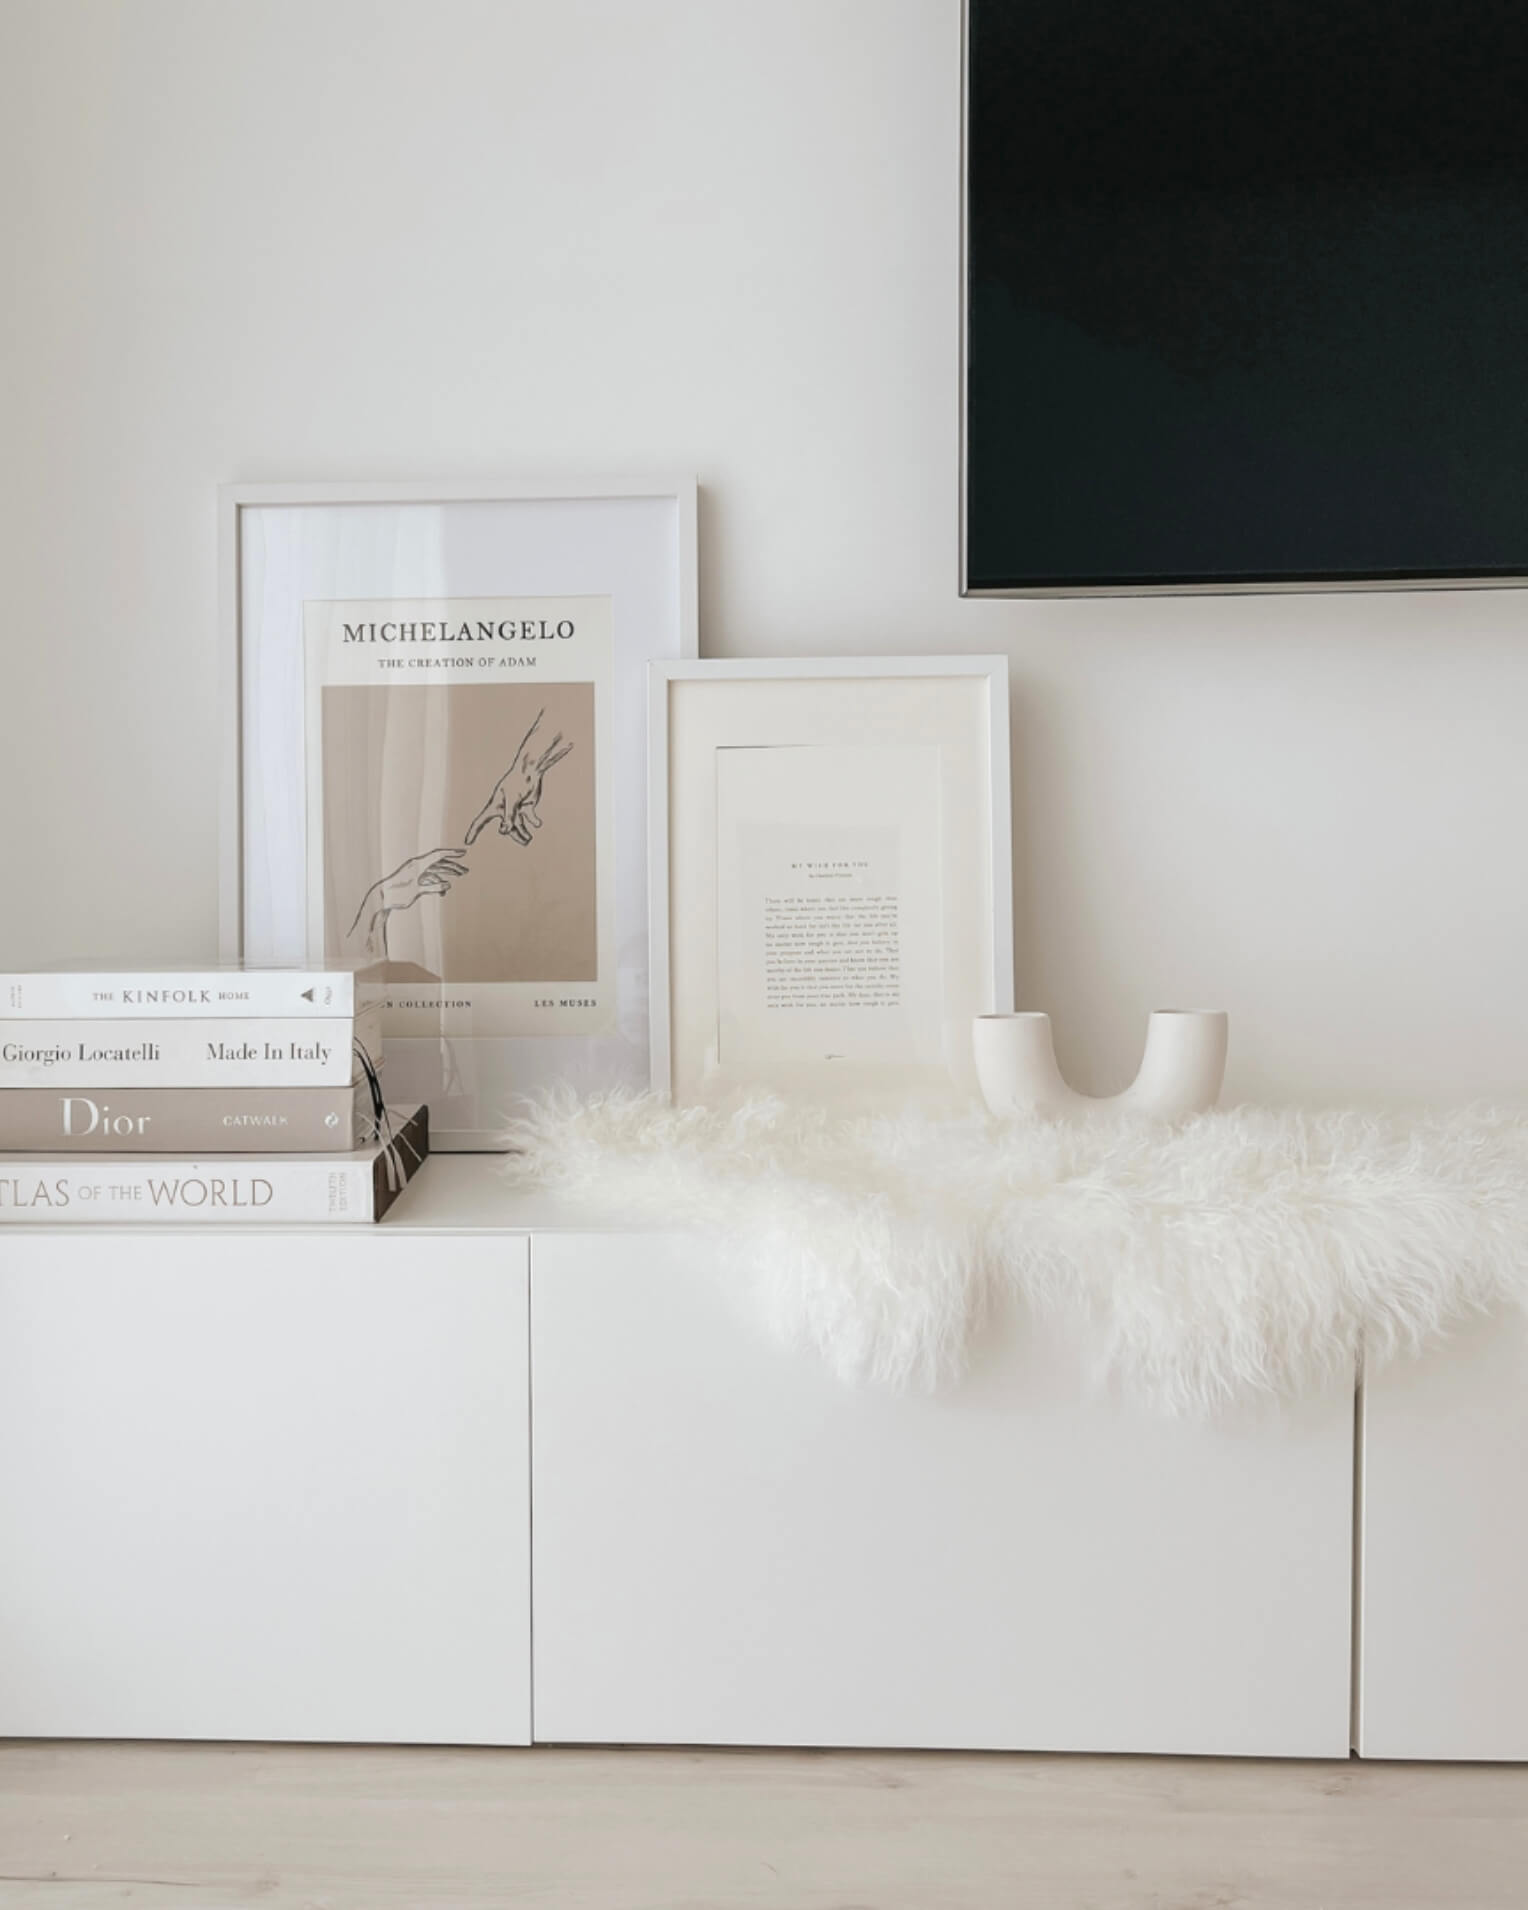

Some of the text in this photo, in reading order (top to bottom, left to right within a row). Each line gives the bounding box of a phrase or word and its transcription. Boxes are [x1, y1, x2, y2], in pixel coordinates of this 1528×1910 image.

[342, 620, 575, 643] MICHELANGELO
[377, 656, 537, 669] THE CREATION OF ADAM
[93, 989, 250, 1004] THE KINFOLK HOME
[398, 1000, 472, 1009] COLLECTION
[534, 999, 598, 1008] LES MUSES
[2, 1043, 160, 1067] Giorgio Locatelli
[207, 1042, 332, 1065] Made In Italy
[61, 1098, 152, 1136] Dior
[222, 1114, 289, 1127] CATWALK
[78, 1185, 102, 1200] OF
[108, 1184, 142, 1200] THE
[147, 1178, 273, 1207] WORLD
